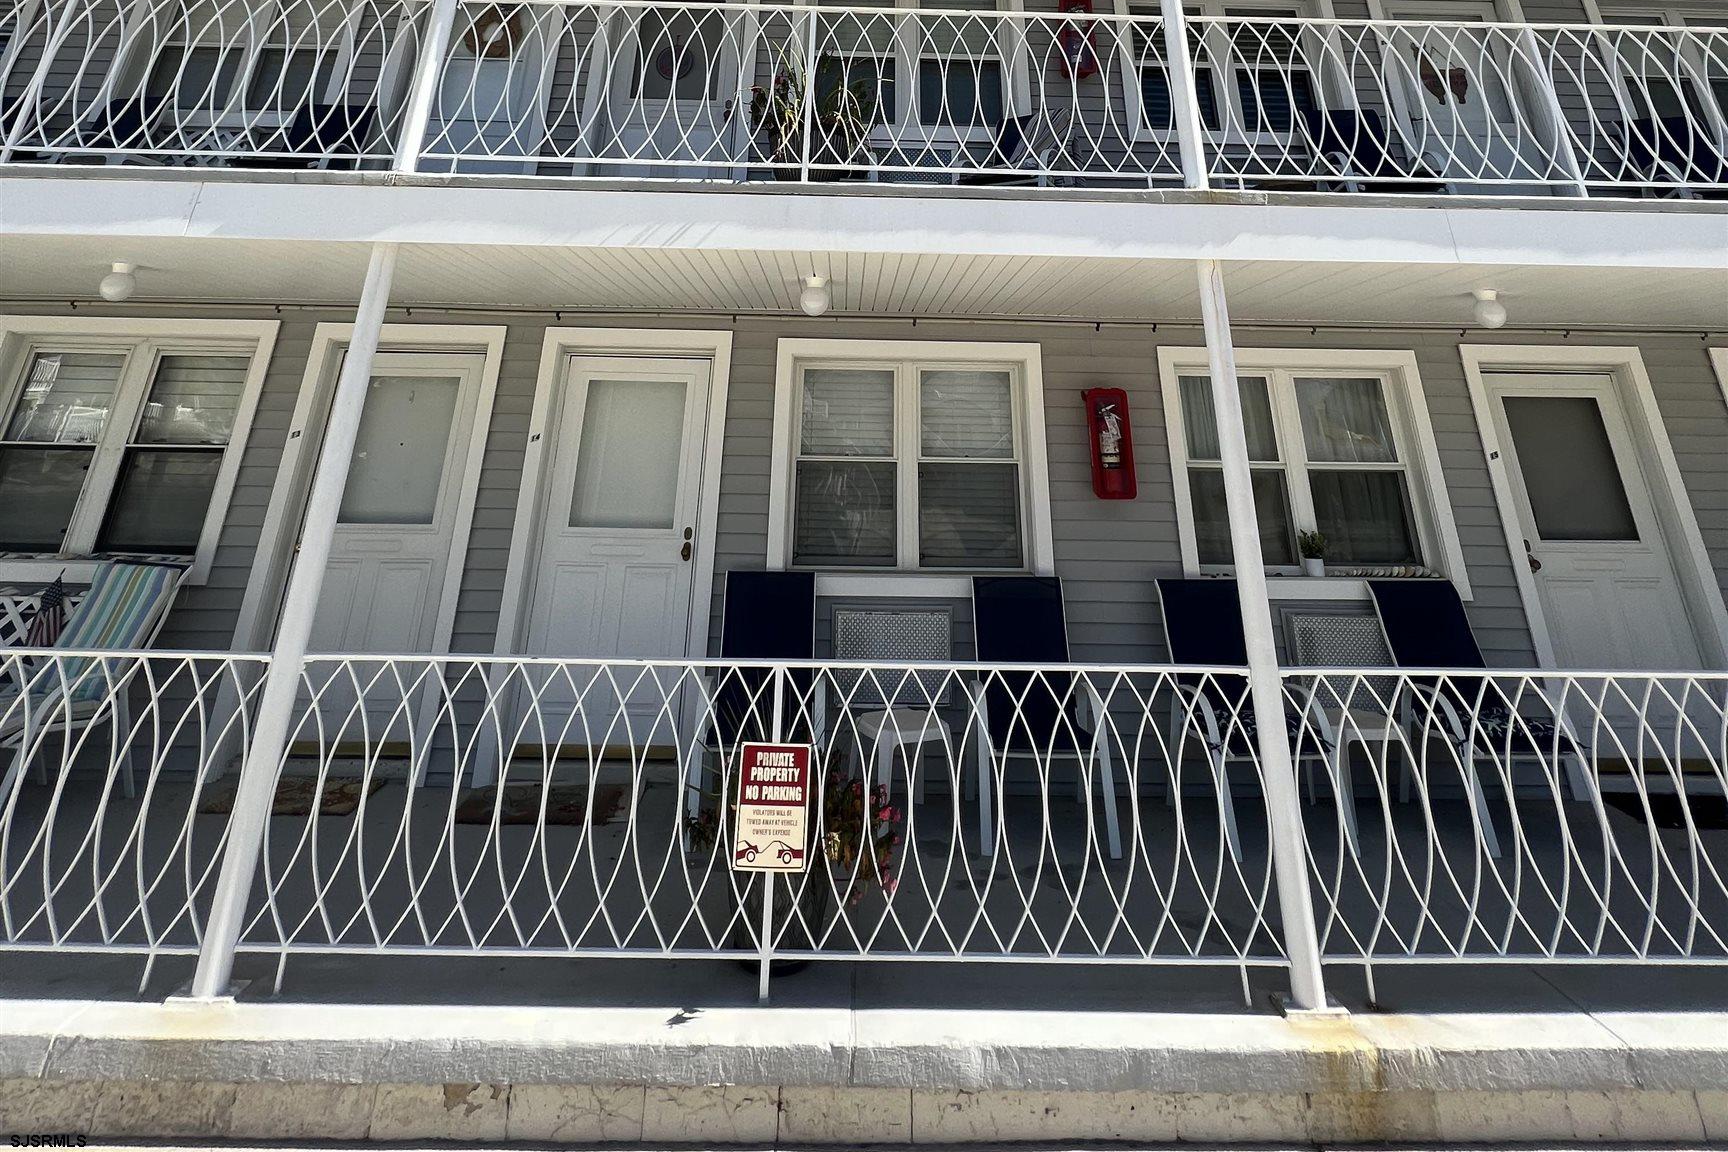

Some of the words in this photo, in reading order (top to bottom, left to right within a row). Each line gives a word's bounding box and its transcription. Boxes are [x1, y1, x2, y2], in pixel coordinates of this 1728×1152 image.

[756, 752, 795, 767] PRIVATE
[750, 767, 800, 782] PROPERTY
[745, 785, 759, 800] NO
[761, 785, 802, 801] PARKING
